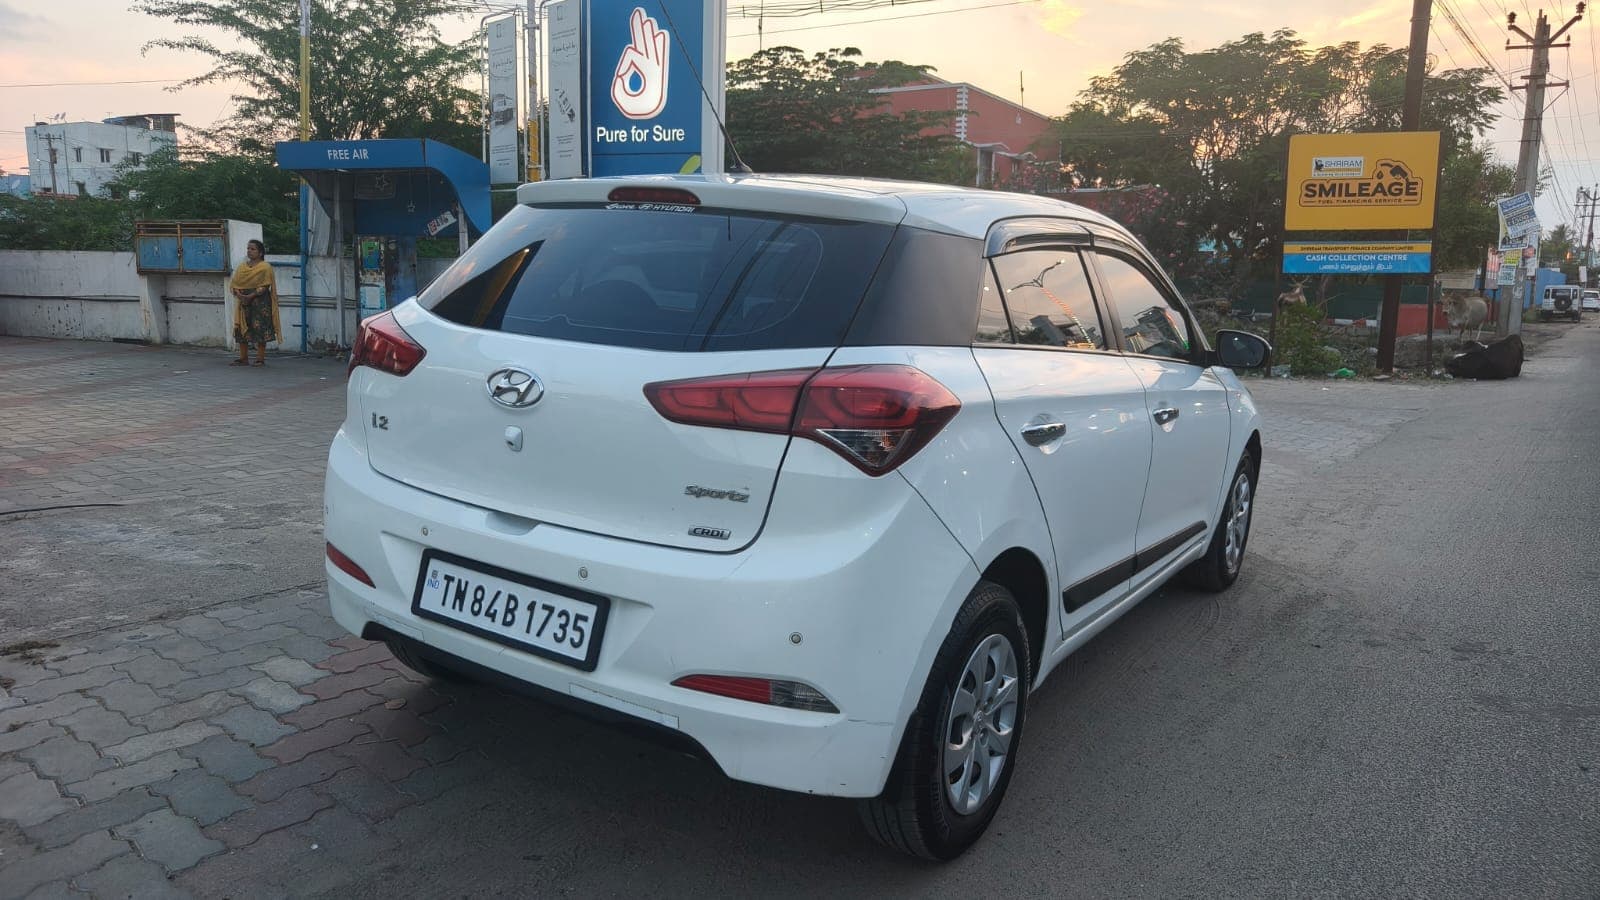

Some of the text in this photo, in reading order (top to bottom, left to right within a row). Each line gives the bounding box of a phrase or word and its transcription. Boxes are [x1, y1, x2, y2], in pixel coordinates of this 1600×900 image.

[596, 124, 685, 143] Pure for Sure
[327, 148, 369, 160] FREE AIR
[1324, 159, 1362, 168] SHRIRAM
[1304, 182, 1419, 199] SMILEAGE
[653, 205, 696, 213] HYUNDAI
[1306, 254, 1327, 262] CASH
[1328, 254, 1377, 262] COLLECTION
[684, 485, 750, 503] Sportz
[427, 578, 440, 590] IND
